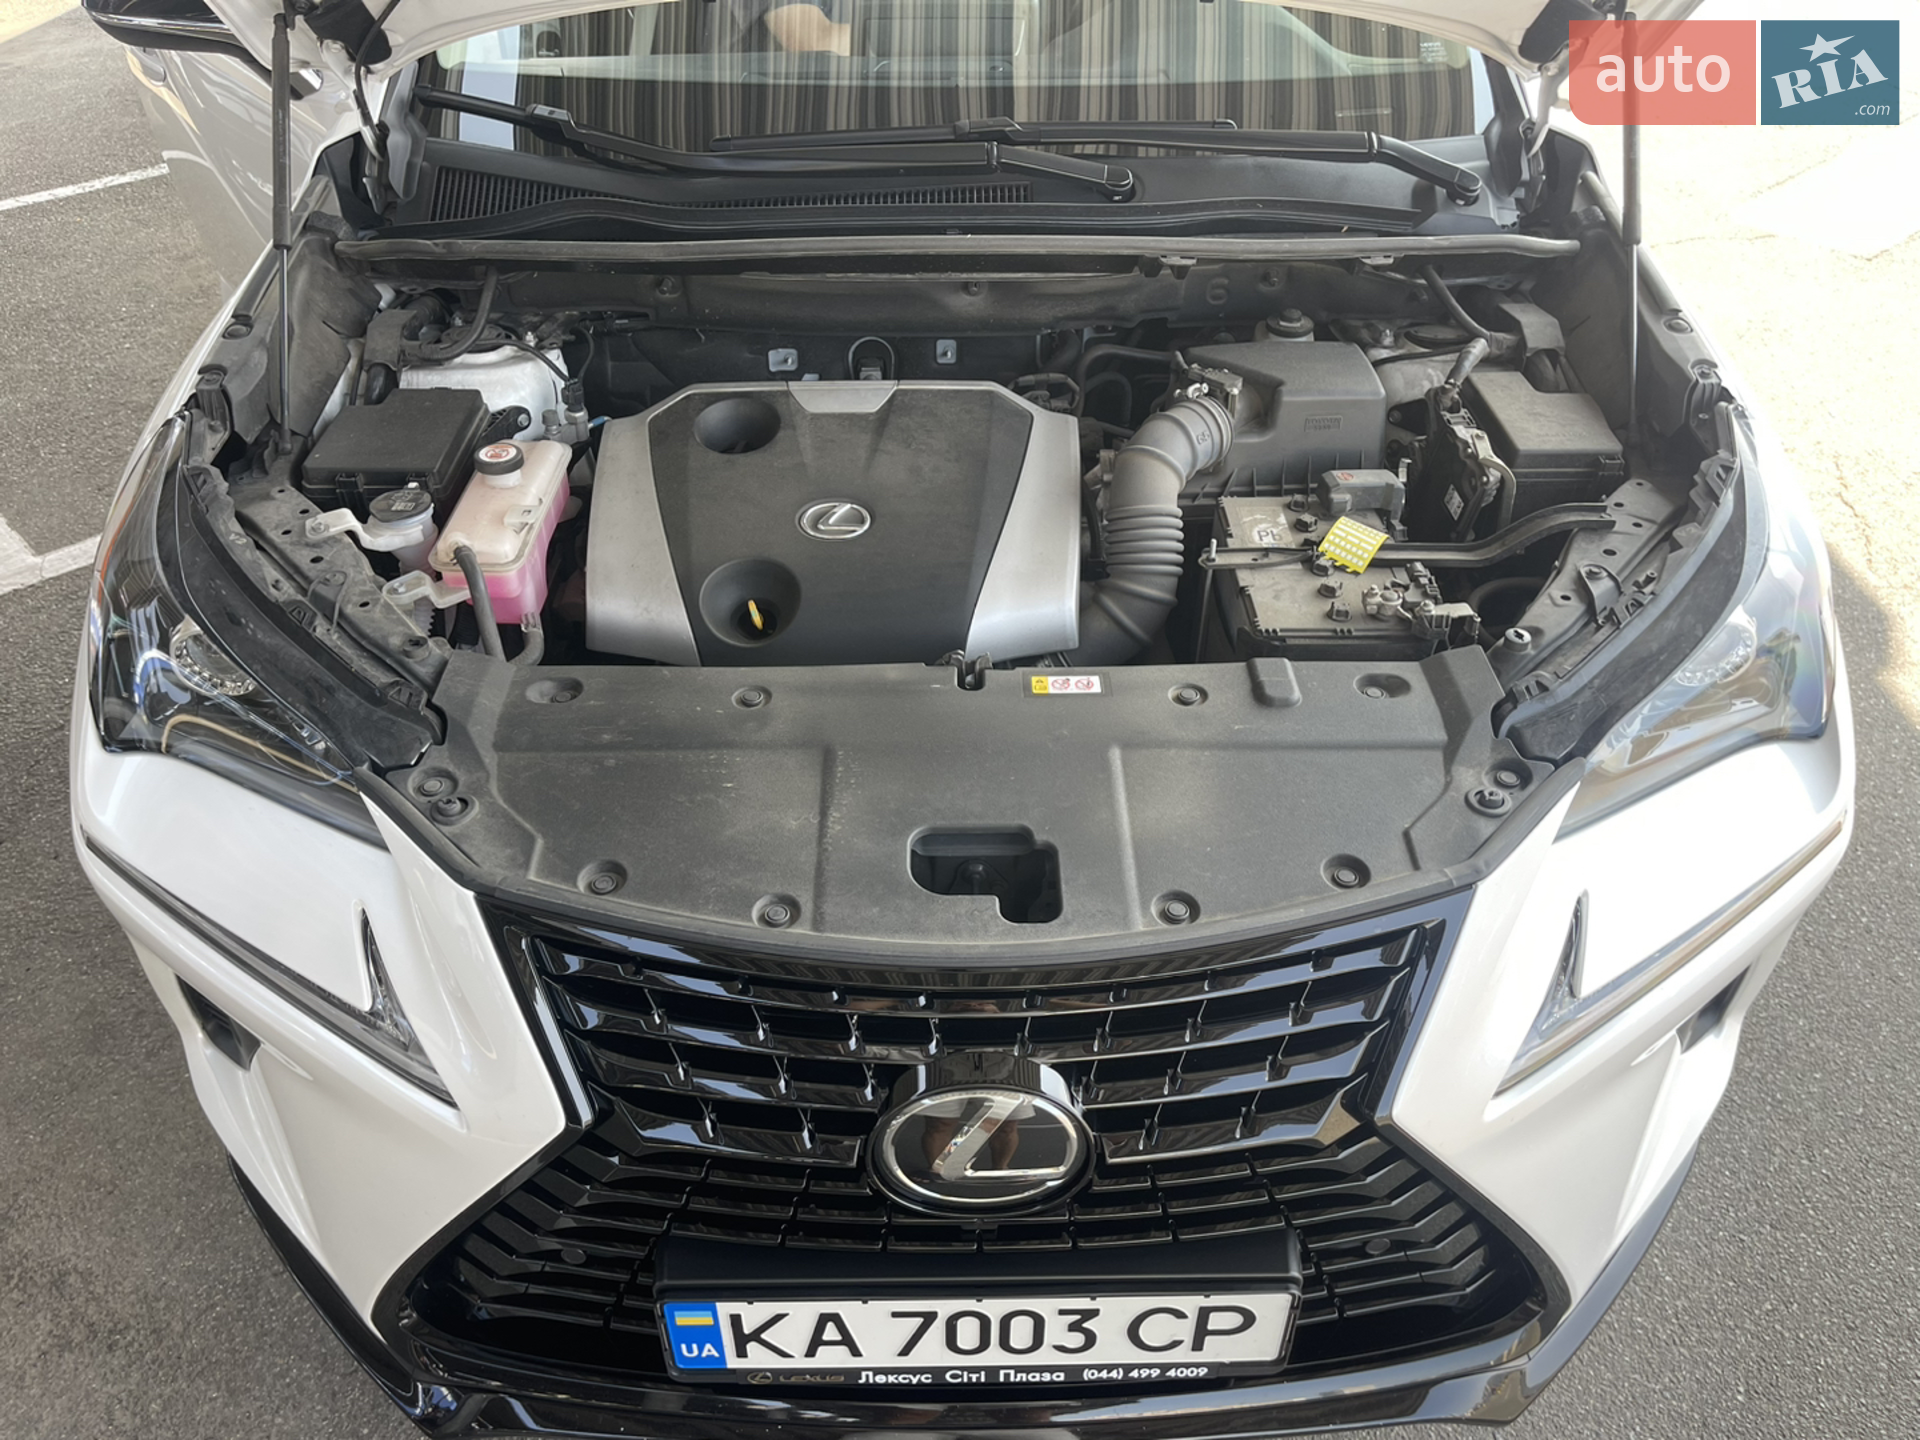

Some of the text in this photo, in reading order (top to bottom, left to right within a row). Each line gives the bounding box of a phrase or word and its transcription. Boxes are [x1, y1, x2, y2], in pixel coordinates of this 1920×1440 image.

[1257, 530, 1283, 542] Pb
[729, 1305, 1257, 1358] KA 7003 CP
[680, 1343, 720, 1358] UA
[858, 1366, 1208, 1384] Лексус Сіті Плаза (044) 499 4009
